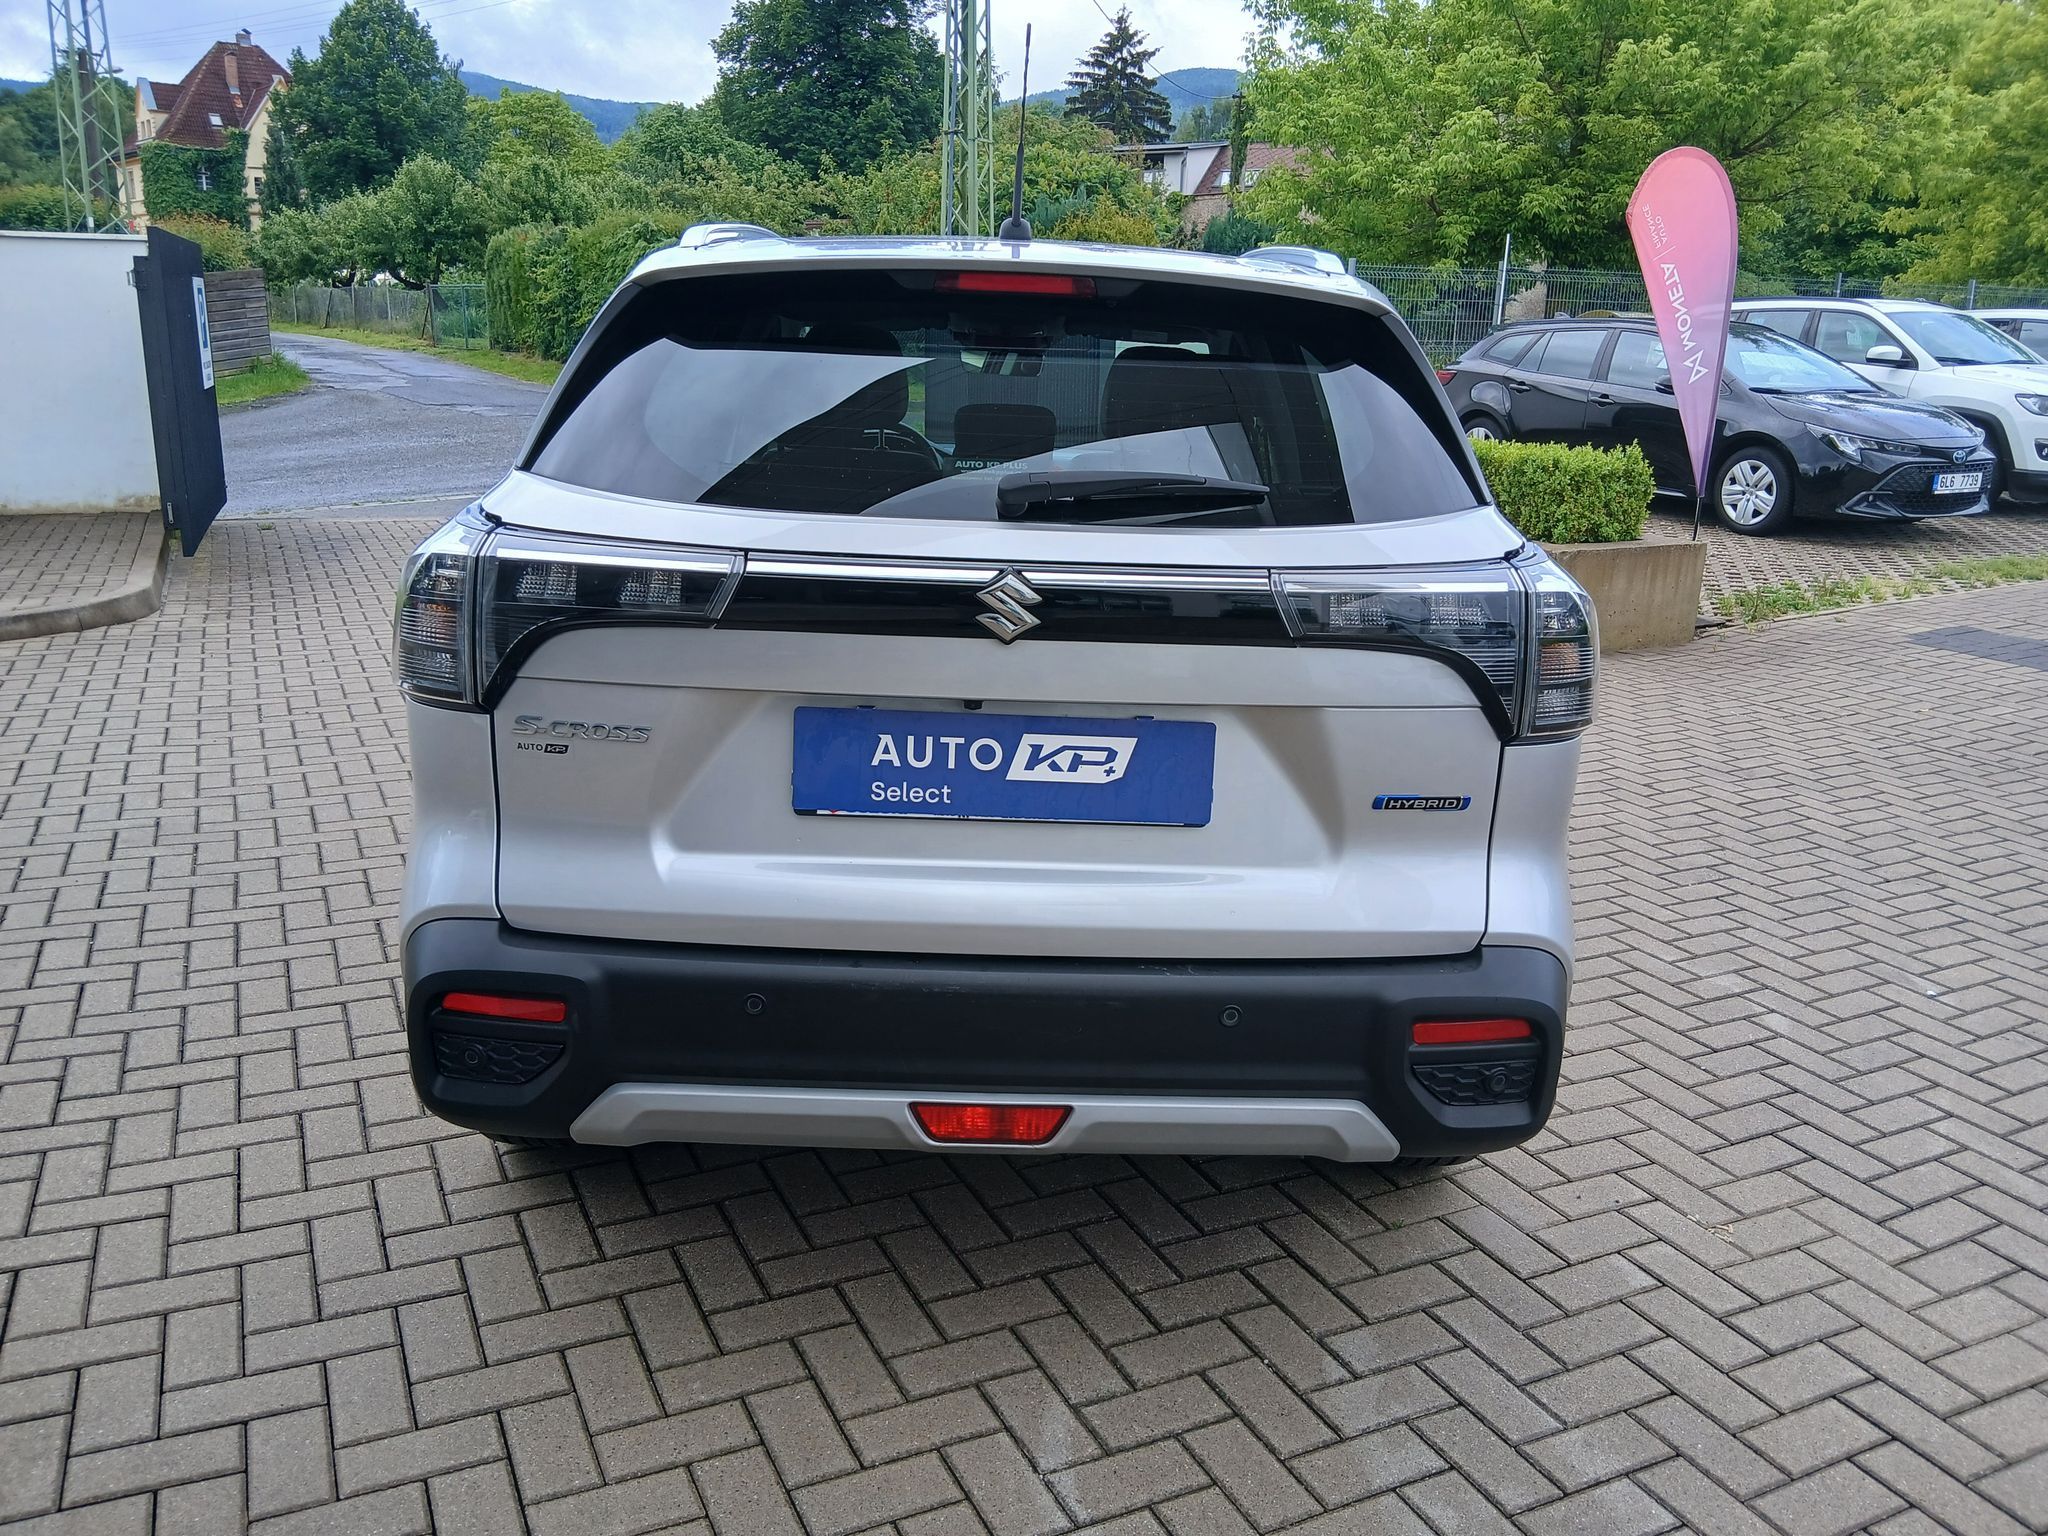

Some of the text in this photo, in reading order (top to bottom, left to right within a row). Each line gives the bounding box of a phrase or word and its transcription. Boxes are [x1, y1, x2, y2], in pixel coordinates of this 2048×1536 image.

[955, 461, 984, 469] AUTO
[1003, 462, 1029, 470] PLUS
[1940, 474, 1979, 488] 6L6 7739
[512, 714, 652, 744] S-CROSS
[517, 742, 544, 752] AUTO
[871, 733, 1003, 772] AUTO
[870, 782, 952, 804] Select
[1388, 799, 1457, 808] HYBRID
